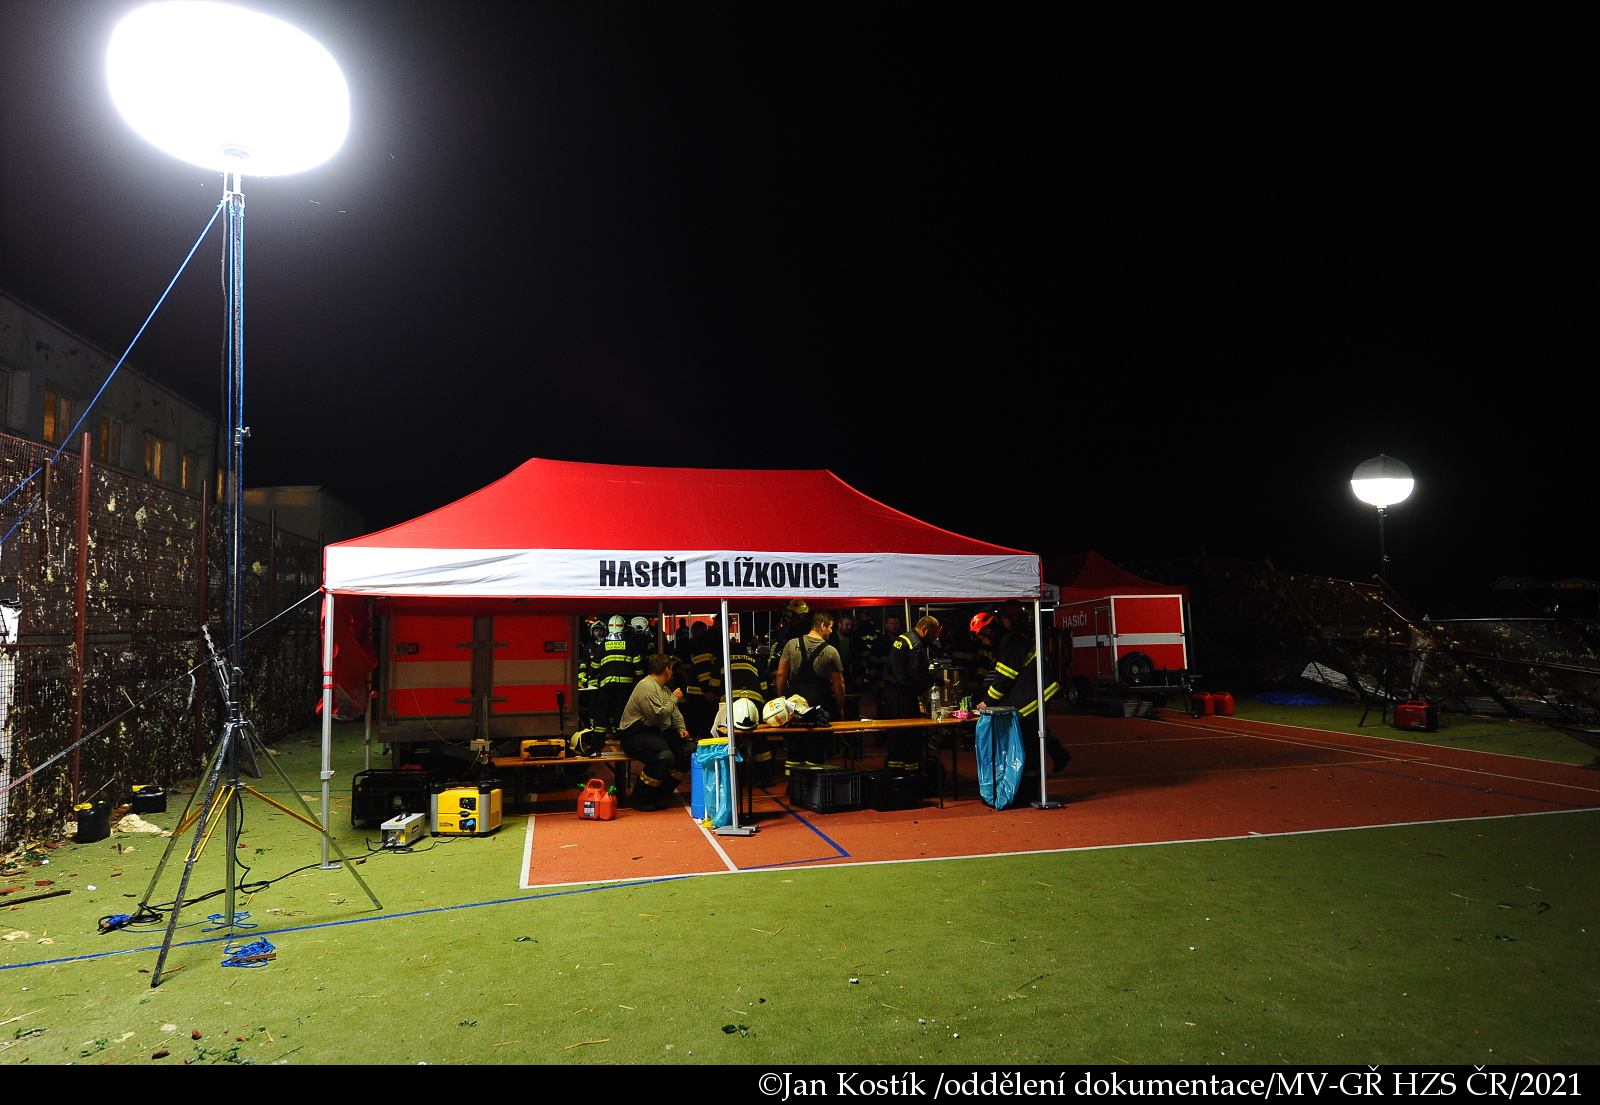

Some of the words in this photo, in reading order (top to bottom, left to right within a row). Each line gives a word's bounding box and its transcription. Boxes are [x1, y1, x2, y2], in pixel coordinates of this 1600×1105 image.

[600, 557, 687, 587] HASIČI
[705, 557, 839, 588] BLÍŽKOVICE
[1062, 611, 1088, 628] HASIČI
